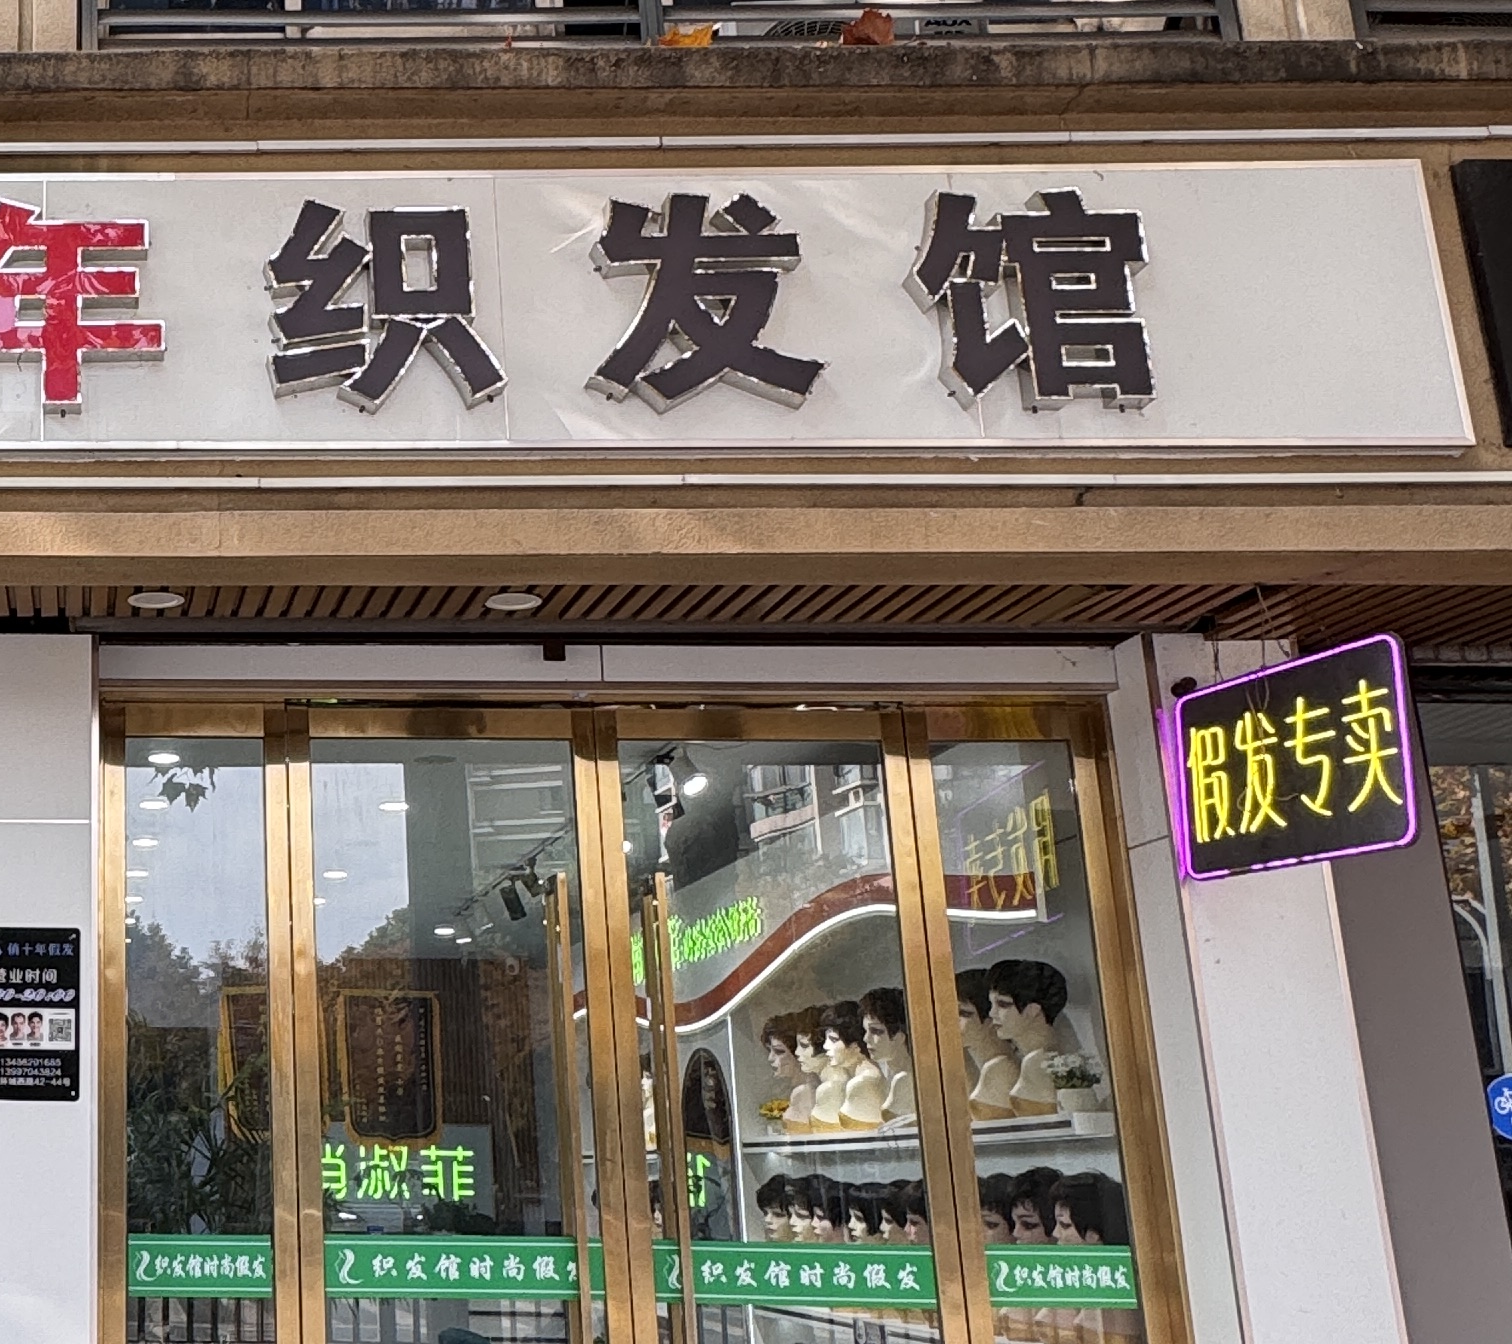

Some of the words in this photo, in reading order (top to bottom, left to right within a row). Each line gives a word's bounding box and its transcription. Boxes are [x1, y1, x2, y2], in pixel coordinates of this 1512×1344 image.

[1187, 679, 1402, 843] 假发专卖
[7, 942, 75, 957] 俏十年假发
[700, 1259, 921, 1292] 织发馆时尚假发
[1013, 1265, 1131, 1293] 织发馆时尚假发
